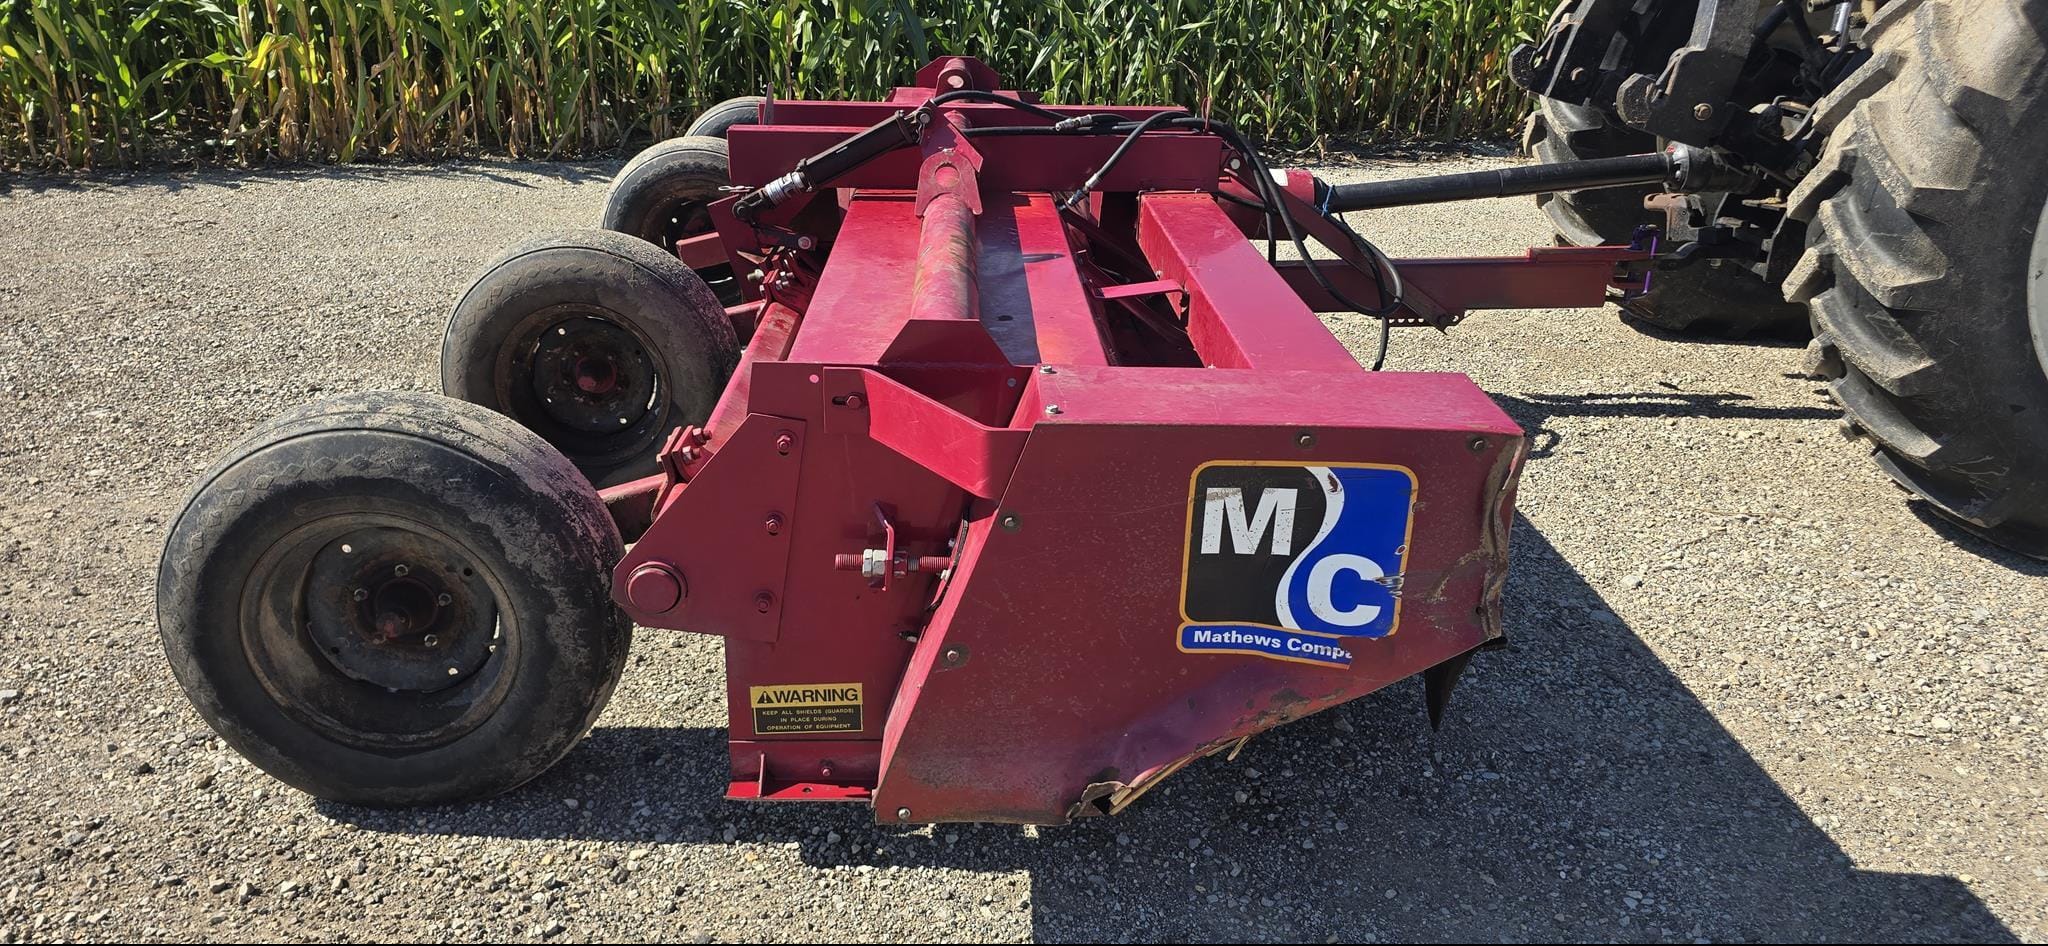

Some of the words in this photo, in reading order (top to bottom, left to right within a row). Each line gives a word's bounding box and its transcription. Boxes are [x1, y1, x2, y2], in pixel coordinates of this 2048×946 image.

[1200, 487, 1298, 556] M
[1306, 553, 1385, 627] C
[1193, 630, 1282, 648] Mathews
[773, 688, 858, 704] WARNING
